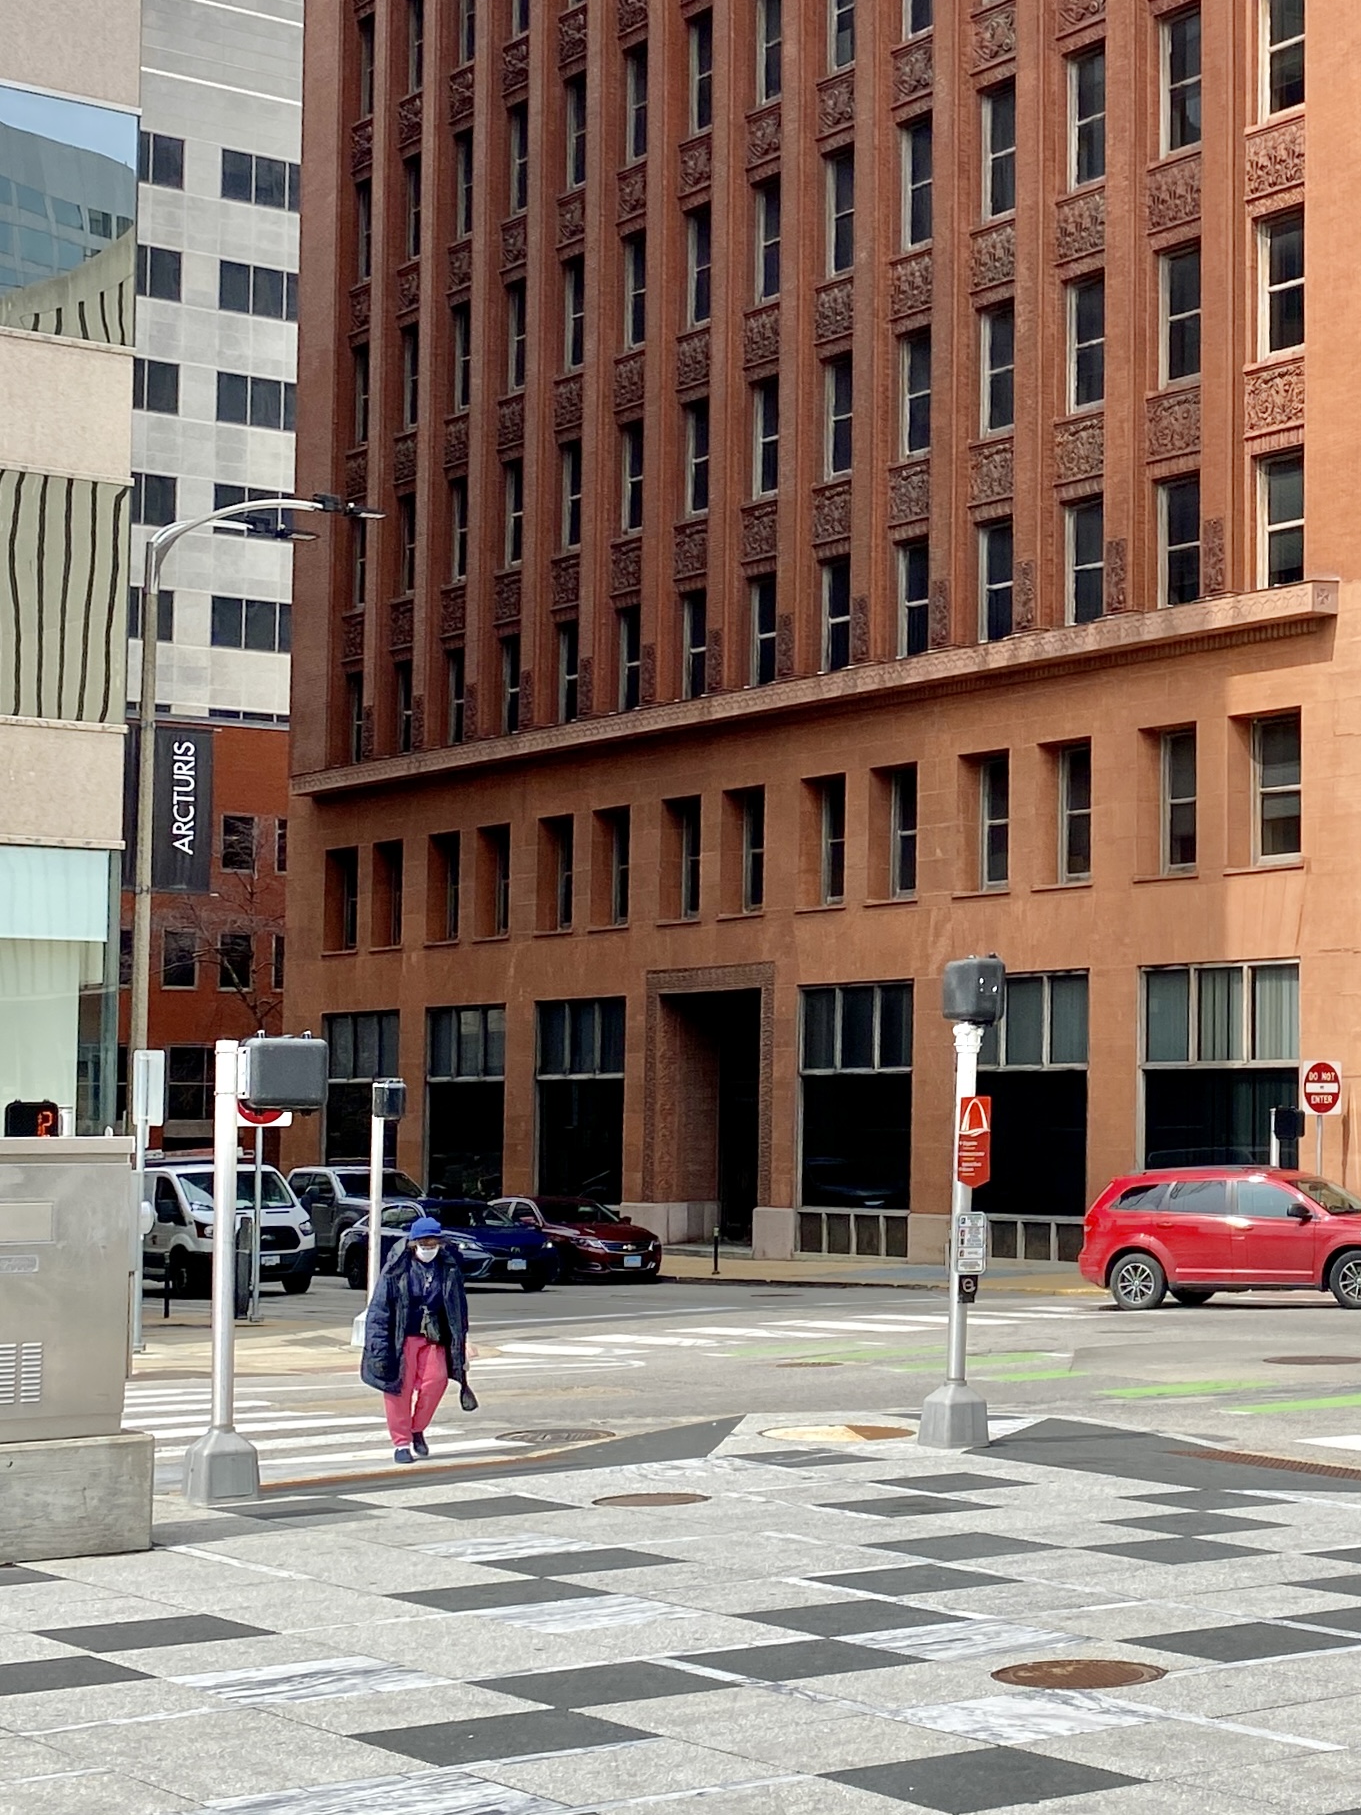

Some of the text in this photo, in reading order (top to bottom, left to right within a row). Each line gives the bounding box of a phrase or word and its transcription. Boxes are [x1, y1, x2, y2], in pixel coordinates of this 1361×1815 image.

[172, 741, 196, 855] ARCTURIS
[1308, 1071, 1335, 1081] DO NOT
[1310, 1094, 1333, 1104] ENTER
